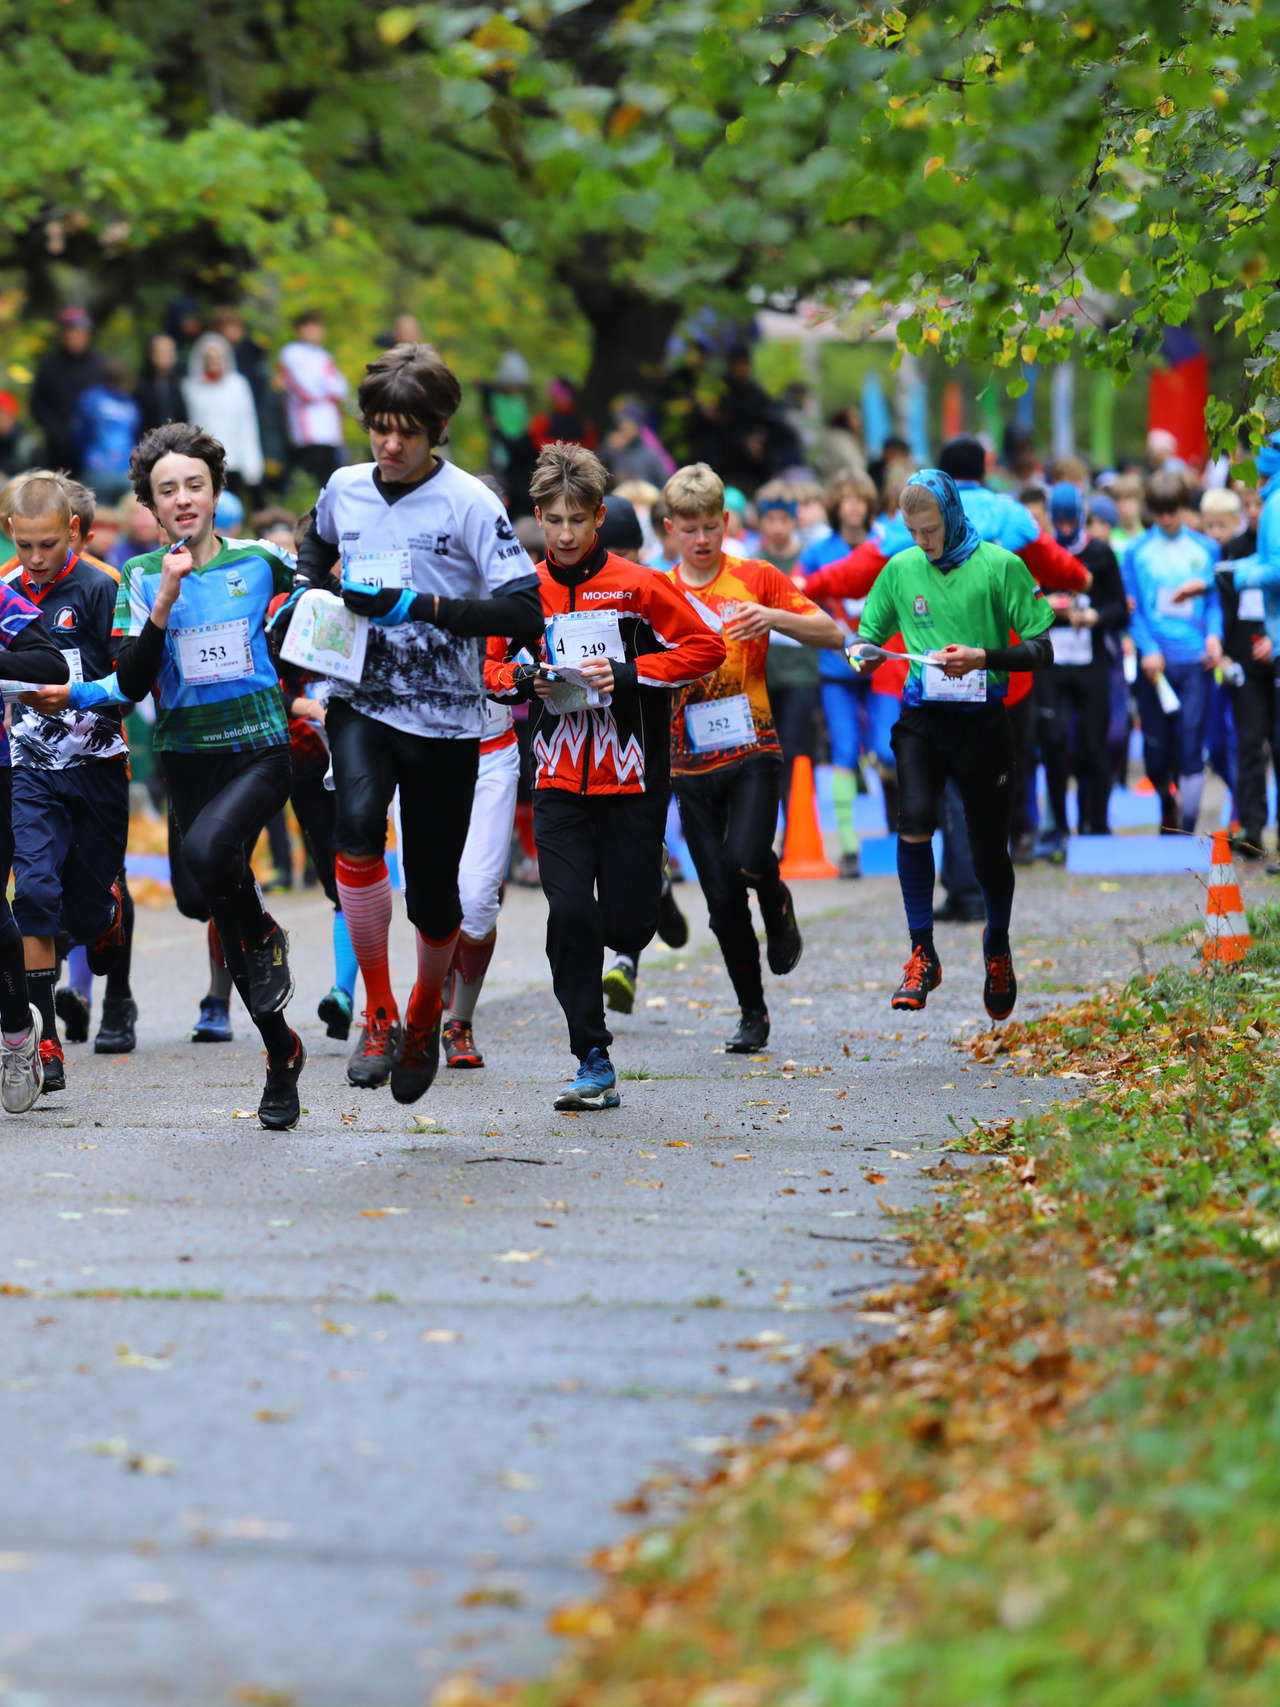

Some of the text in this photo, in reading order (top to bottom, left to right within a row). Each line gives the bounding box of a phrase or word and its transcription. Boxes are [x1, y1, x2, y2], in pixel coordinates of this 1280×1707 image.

[582, 591, 632, 600] МОСКВА
[199, 646, 227, 662] 253
[580, 641, 606, 658] 249
[202, 721, 270, 742] www.belcdtur.ru
[708, 717, 731, 733] 252
